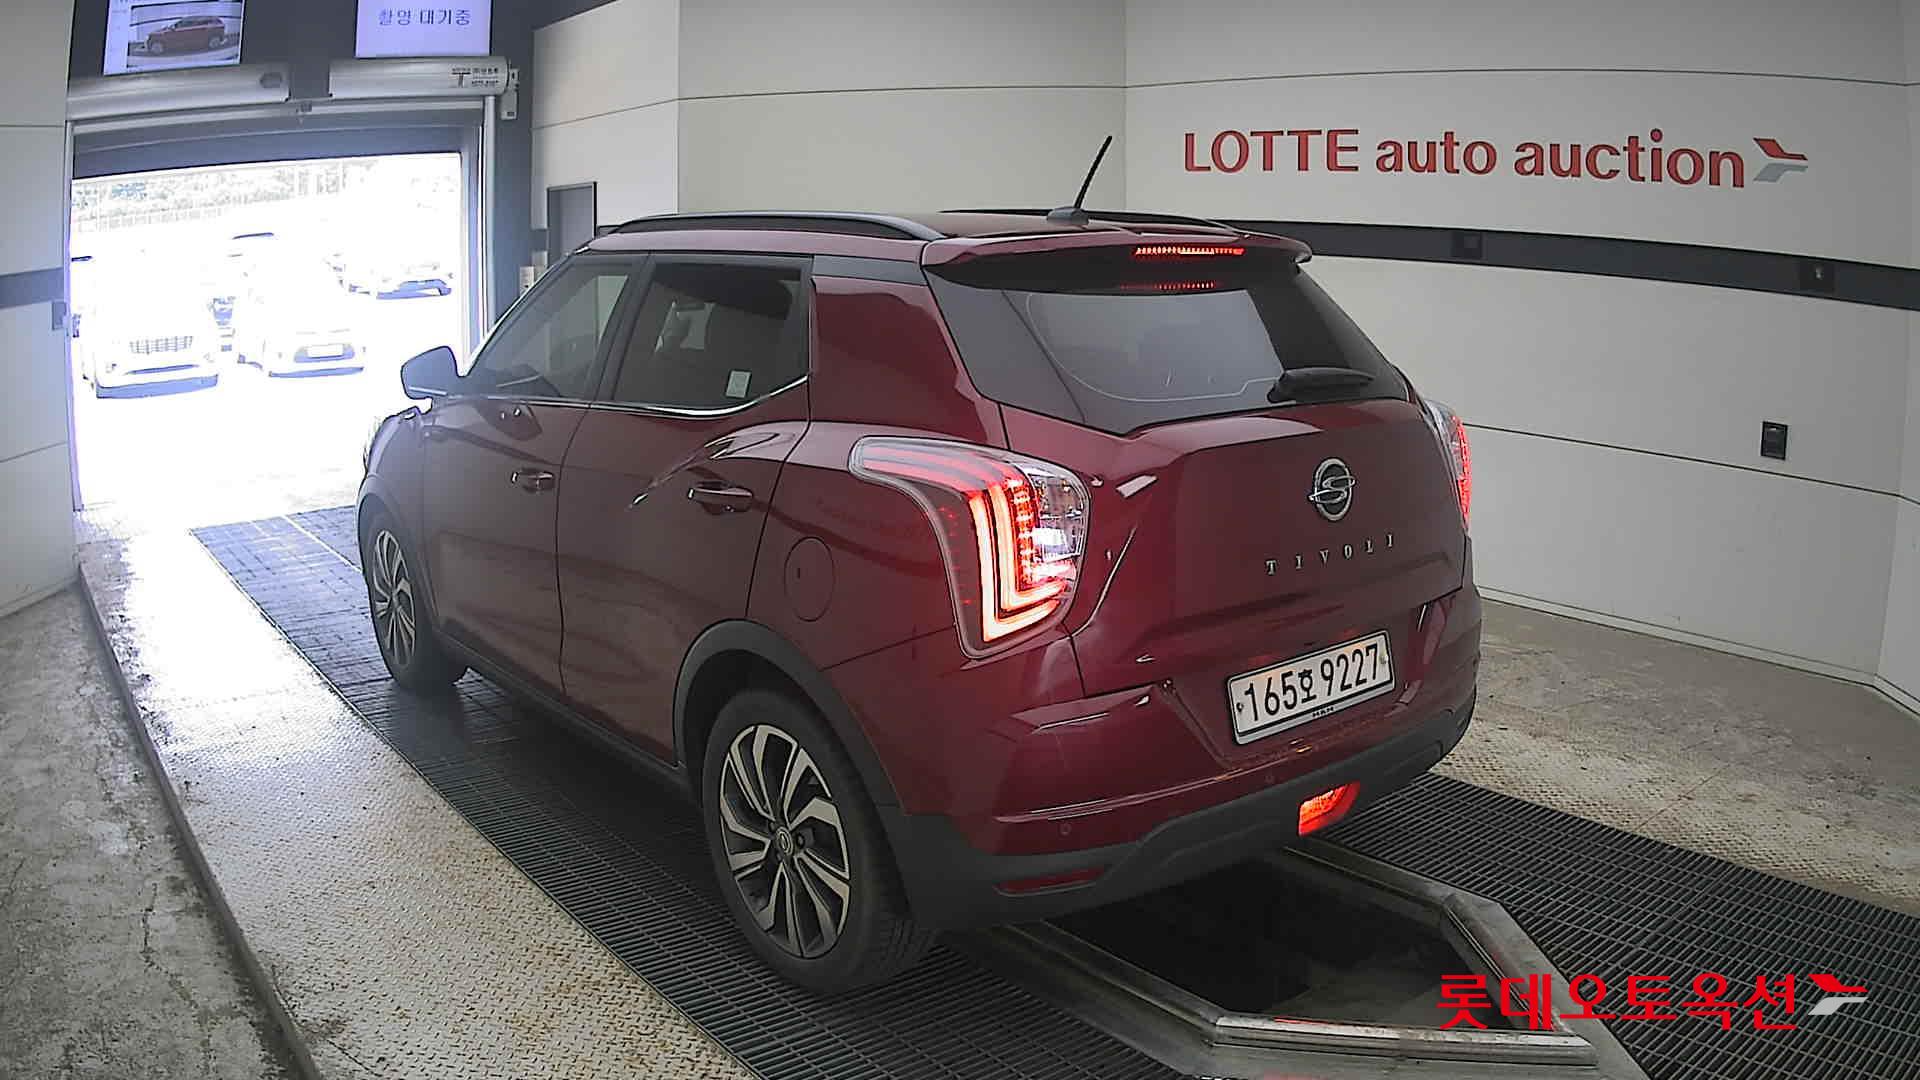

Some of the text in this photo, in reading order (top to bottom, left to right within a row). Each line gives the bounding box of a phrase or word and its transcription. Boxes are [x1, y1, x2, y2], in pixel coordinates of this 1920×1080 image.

[419, 9, 471, 26] 대기중
[1184, 128, 1745, 188] LOTTE auto auction
[1266, 534, 1394, 575] TIVOLI
